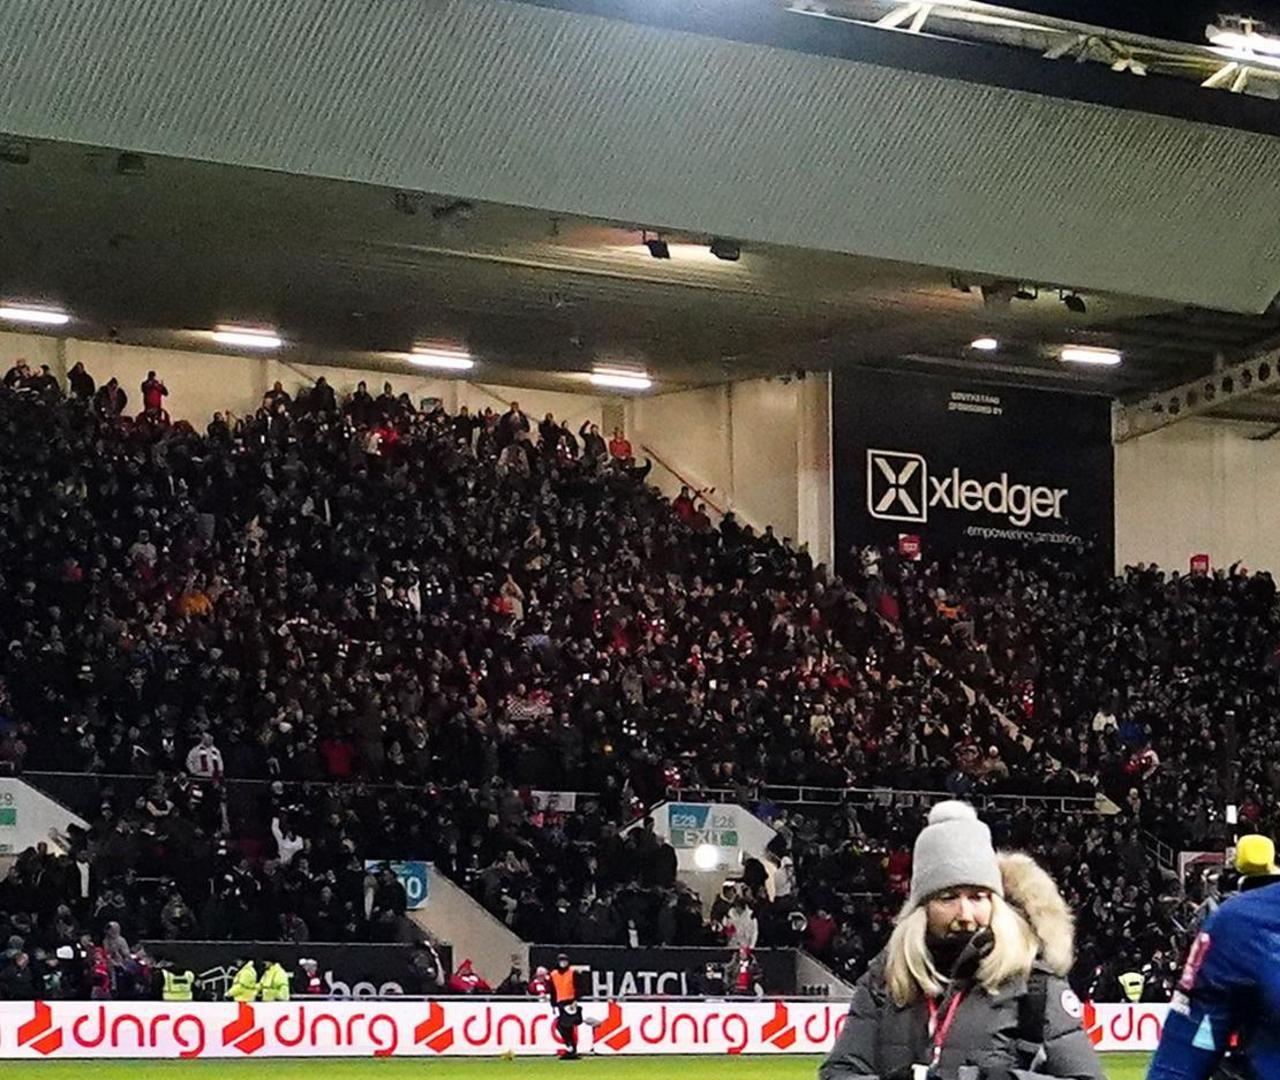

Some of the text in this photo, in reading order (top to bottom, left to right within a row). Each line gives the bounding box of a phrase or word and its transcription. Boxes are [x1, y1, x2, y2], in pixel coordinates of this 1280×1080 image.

[929, 467, 1068, 527] xledger
[72, 1005, 206, 1060] dnrg
[274, 1006, 399, 1059] dnrg
[640, 1006, 749, 1055] dnrg
